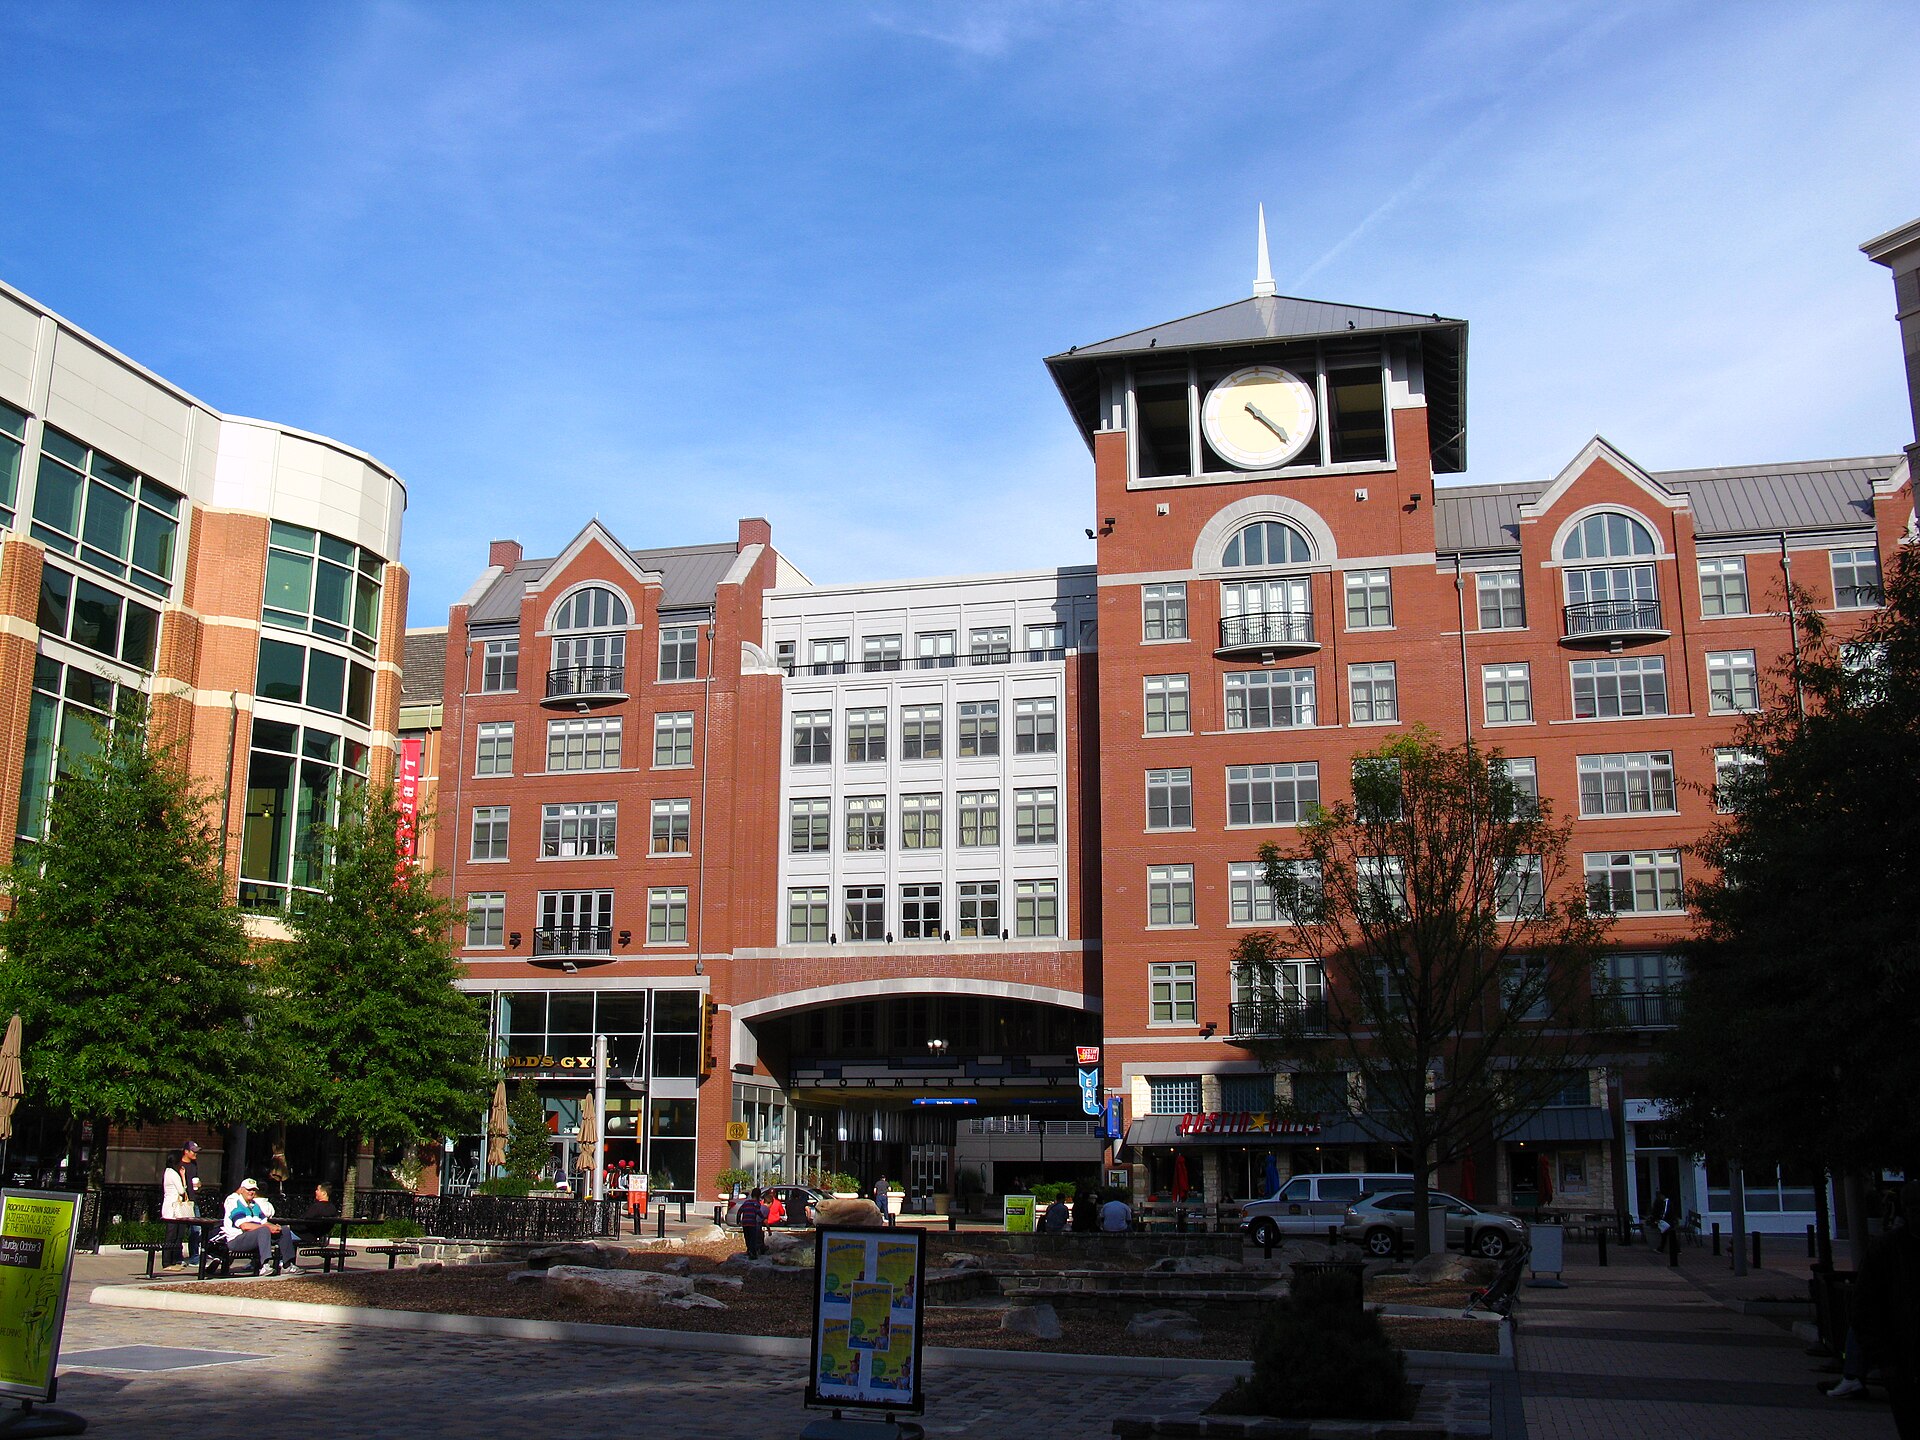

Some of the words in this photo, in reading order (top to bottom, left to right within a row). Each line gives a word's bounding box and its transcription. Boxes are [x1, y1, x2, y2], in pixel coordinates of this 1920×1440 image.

[814, 1078, 1005, 1087] COMMERCE
[1085, 1078, 1093, 1109] EAT
[1180, 1112, 1250, 1135] AUSTIN
[7, 1203, 30, 1212] ROCKVILLE
[30, 1205, 43, 1214] TOWN
[43, 1206, 61, 1215] SQUARE
